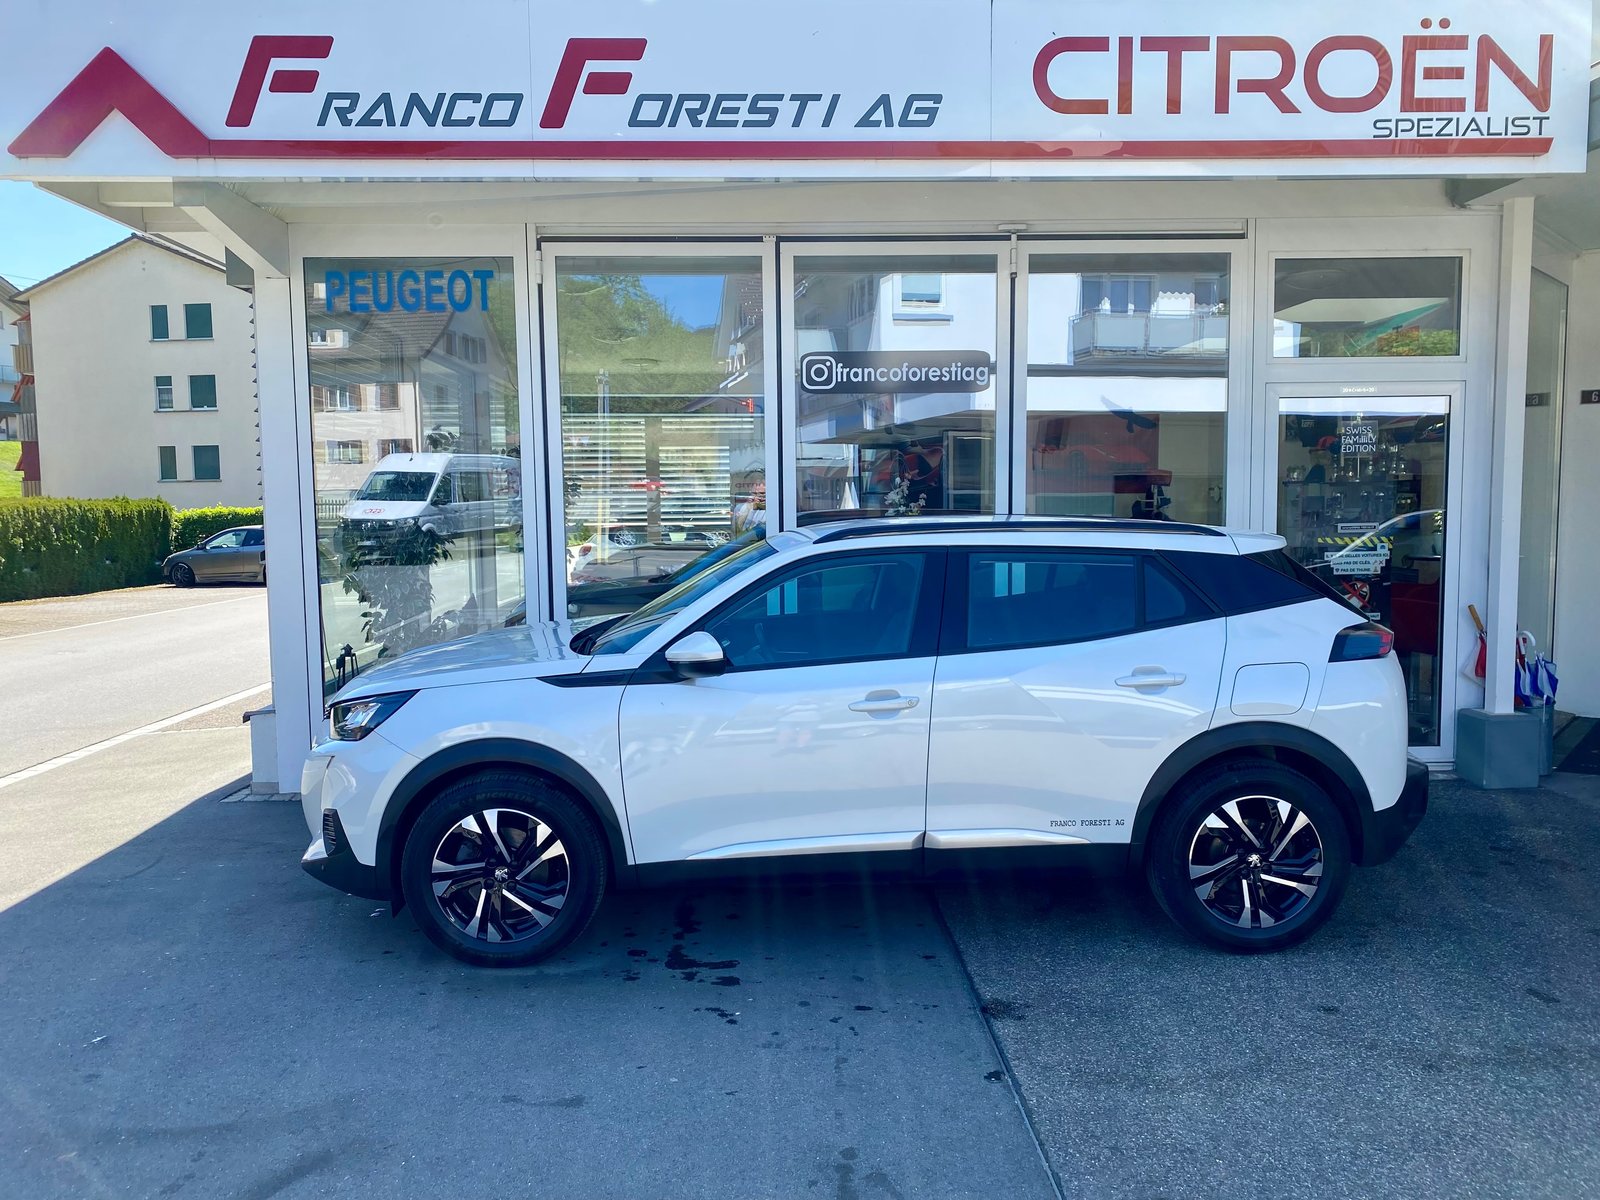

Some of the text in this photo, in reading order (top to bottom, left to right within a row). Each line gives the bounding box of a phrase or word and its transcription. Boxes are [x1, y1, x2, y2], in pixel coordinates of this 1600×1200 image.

[1032, 17, 1555, 114] CITROËN
[224, 35, 944, 129] FRANCO FORESTI AG
[1372, 116, 1551, 139] SPEZIALIST
[325, 268, 494, 314] PEUGEOT
[836, 362, 990, 386] francoforestiag
[1346, 426, 1373, 434] SWISS
[1341, 444, 1376, 453] EDITION
